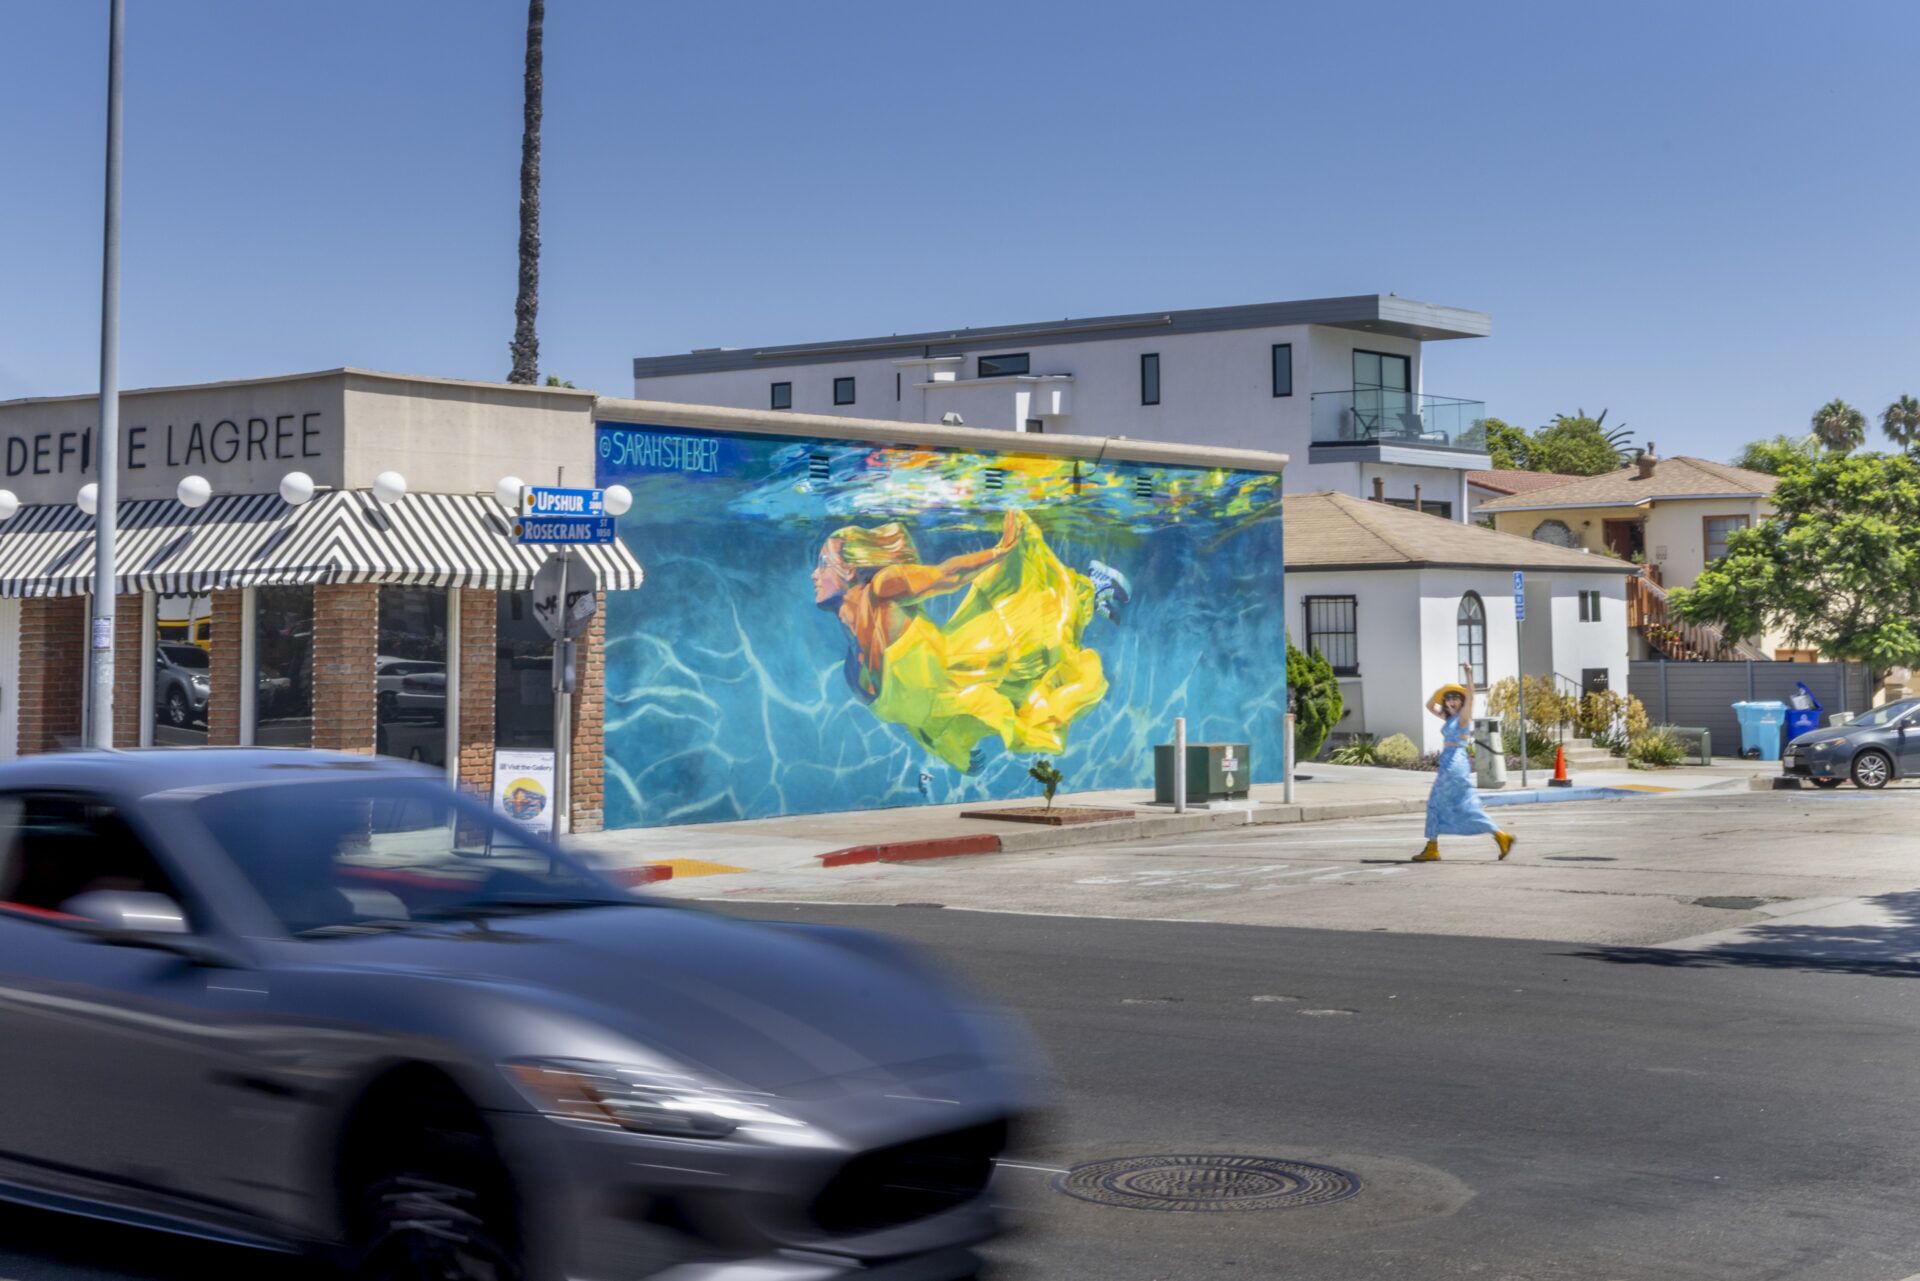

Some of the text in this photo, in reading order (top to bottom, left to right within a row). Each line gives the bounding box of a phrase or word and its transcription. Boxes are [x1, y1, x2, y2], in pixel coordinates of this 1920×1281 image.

[6, 412, 322, 477] DEFIE LAGREE
[537, 491, 600, 512] UPSHUR ST
[524, 519, 608, 540] ROSECRANS ST
[532, 764, 553, 772] Gallery
